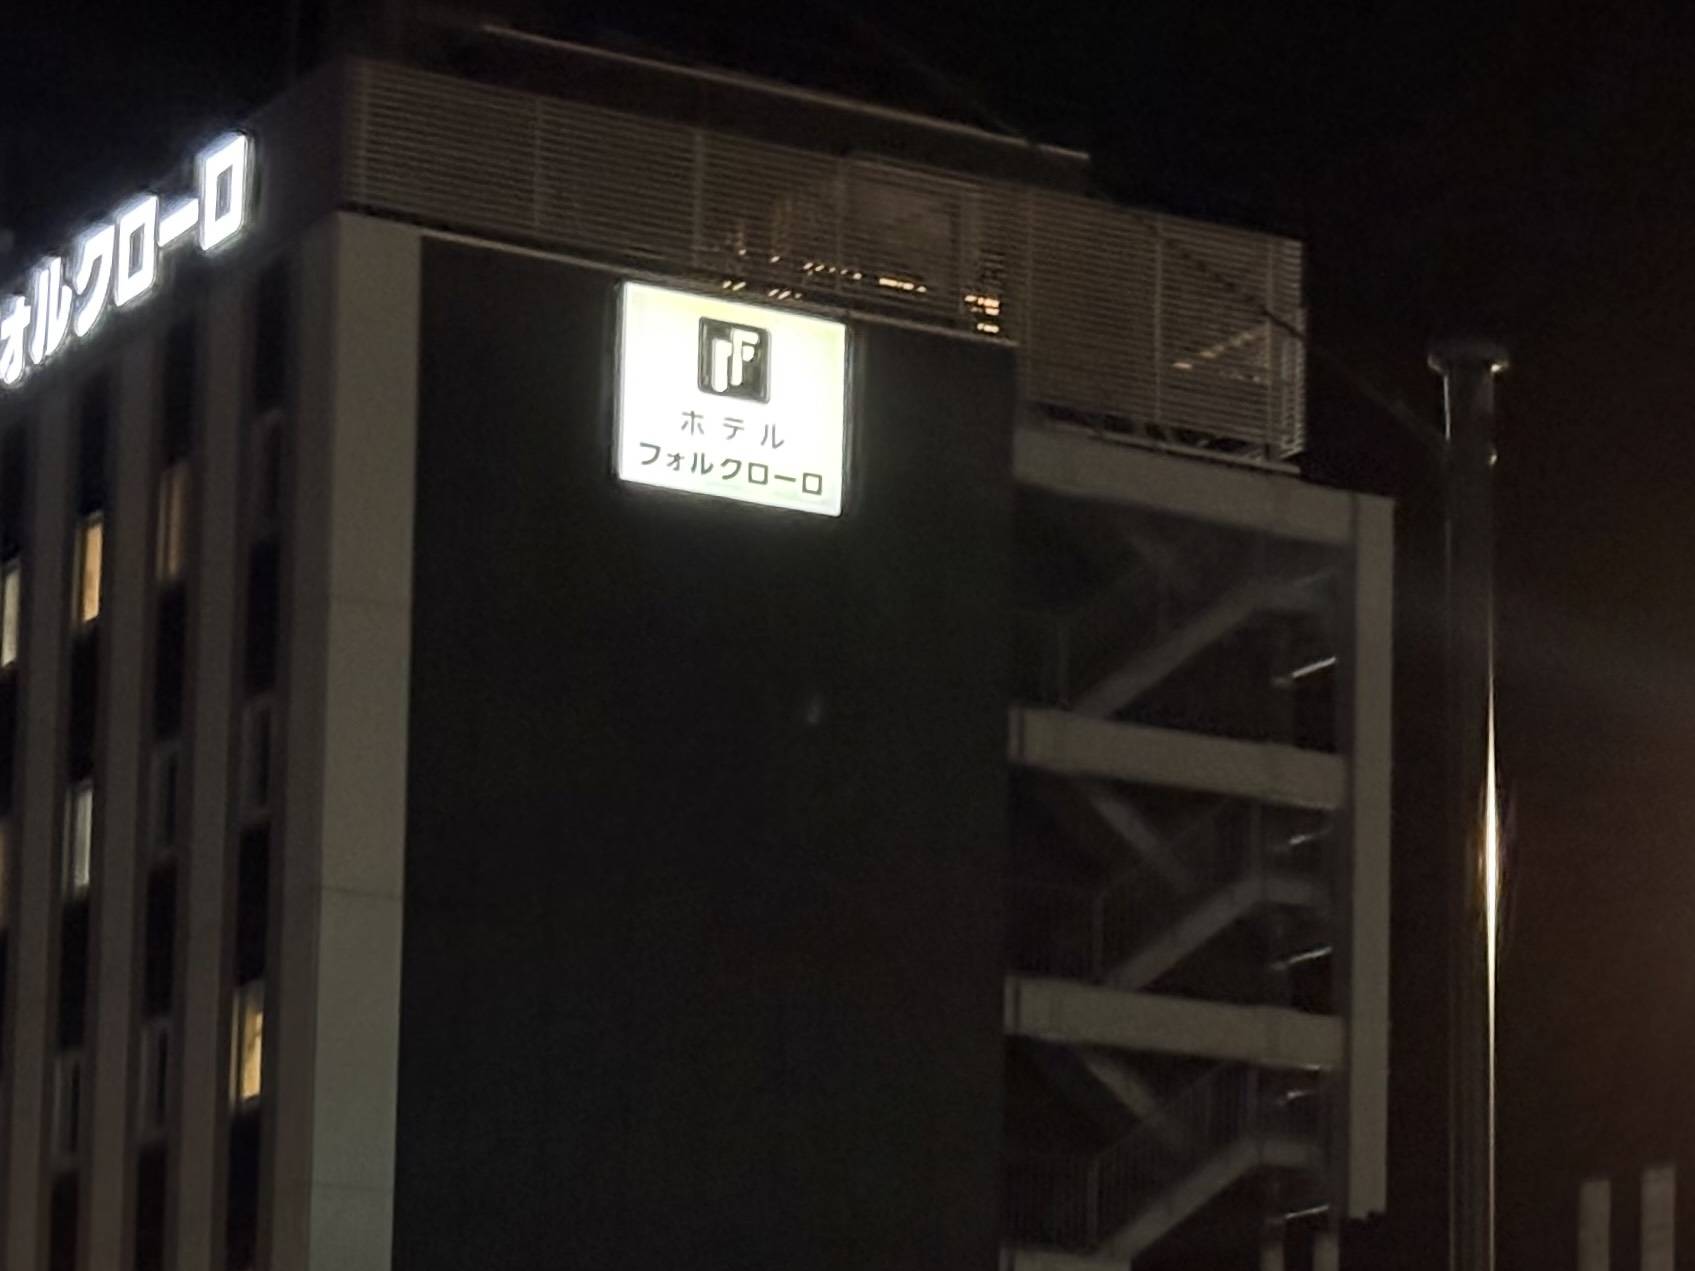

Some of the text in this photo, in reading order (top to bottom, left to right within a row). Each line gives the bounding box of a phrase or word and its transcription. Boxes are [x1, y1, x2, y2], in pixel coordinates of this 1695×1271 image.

[681, 410, 784, 449] ホテル
[640, 442, 822, 495] フォルクローロ
